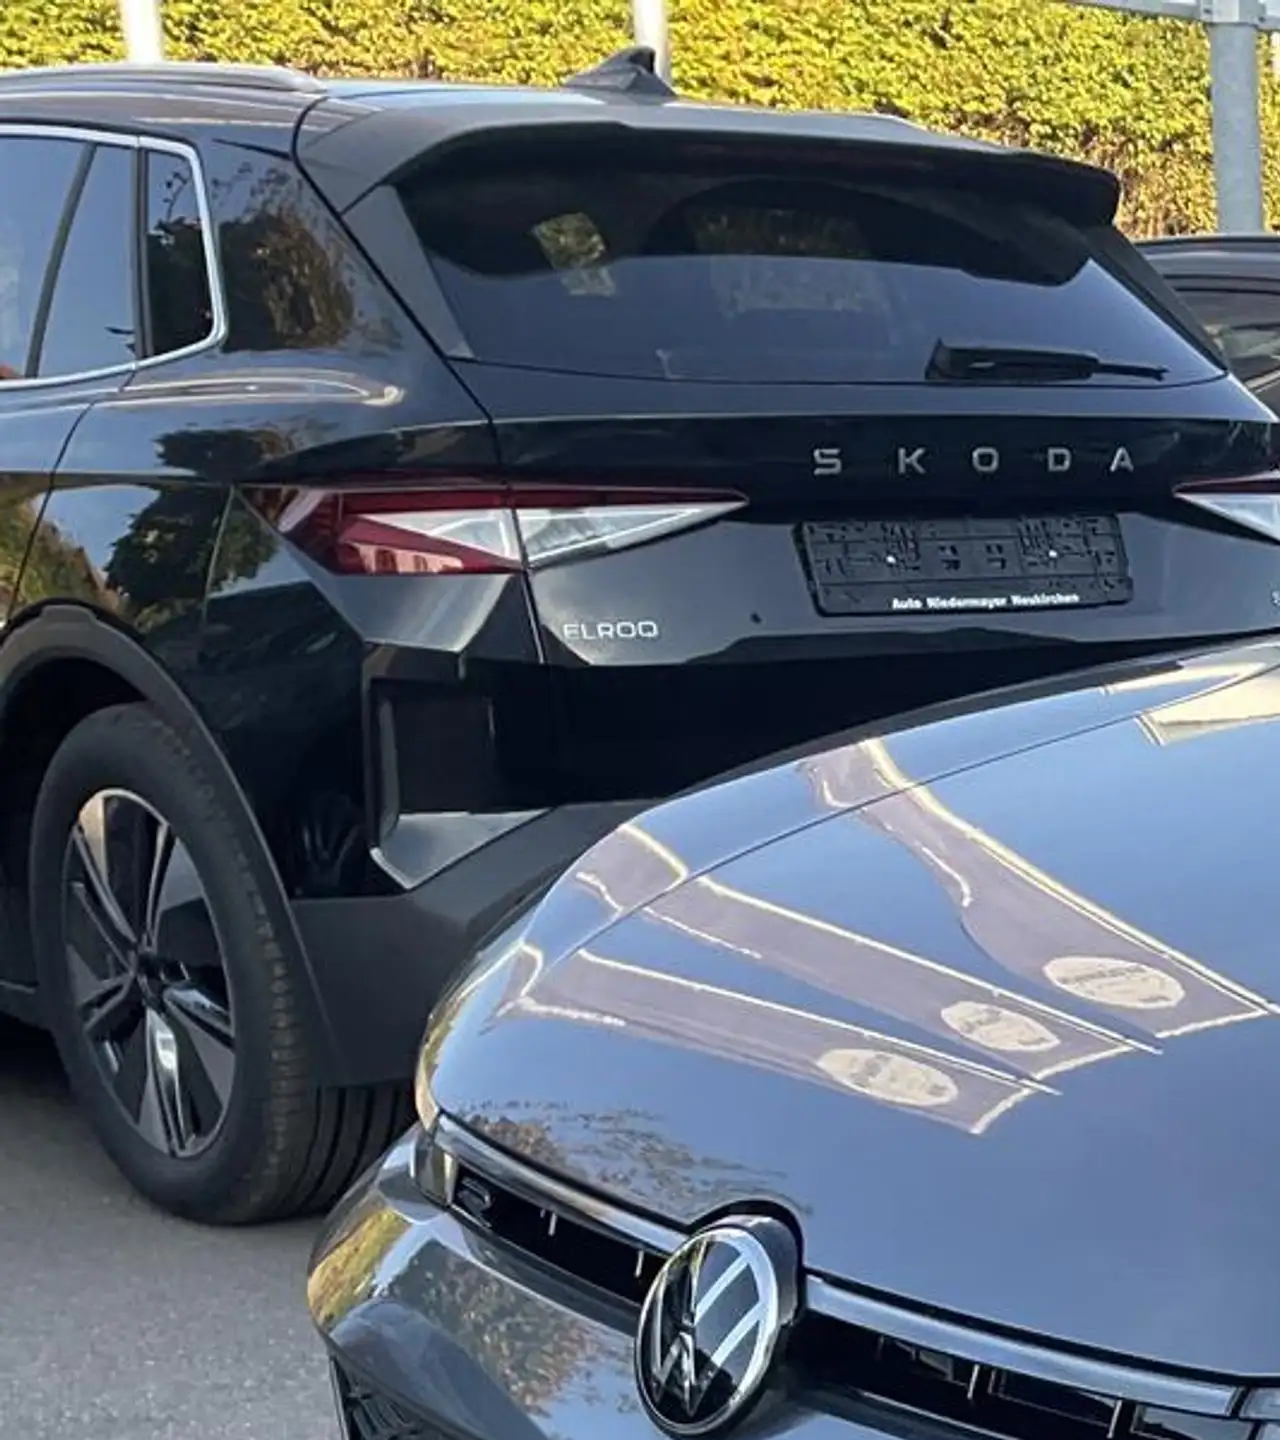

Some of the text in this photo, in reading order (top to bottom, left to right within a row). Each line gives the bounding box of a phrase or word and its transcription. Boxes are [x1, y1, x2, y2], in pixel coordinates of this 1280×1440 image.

[812, 447, 1135, 476] SKODA
[892, 597, 922, 611] Auto
[562, 620, 660, 640] ELROQ
